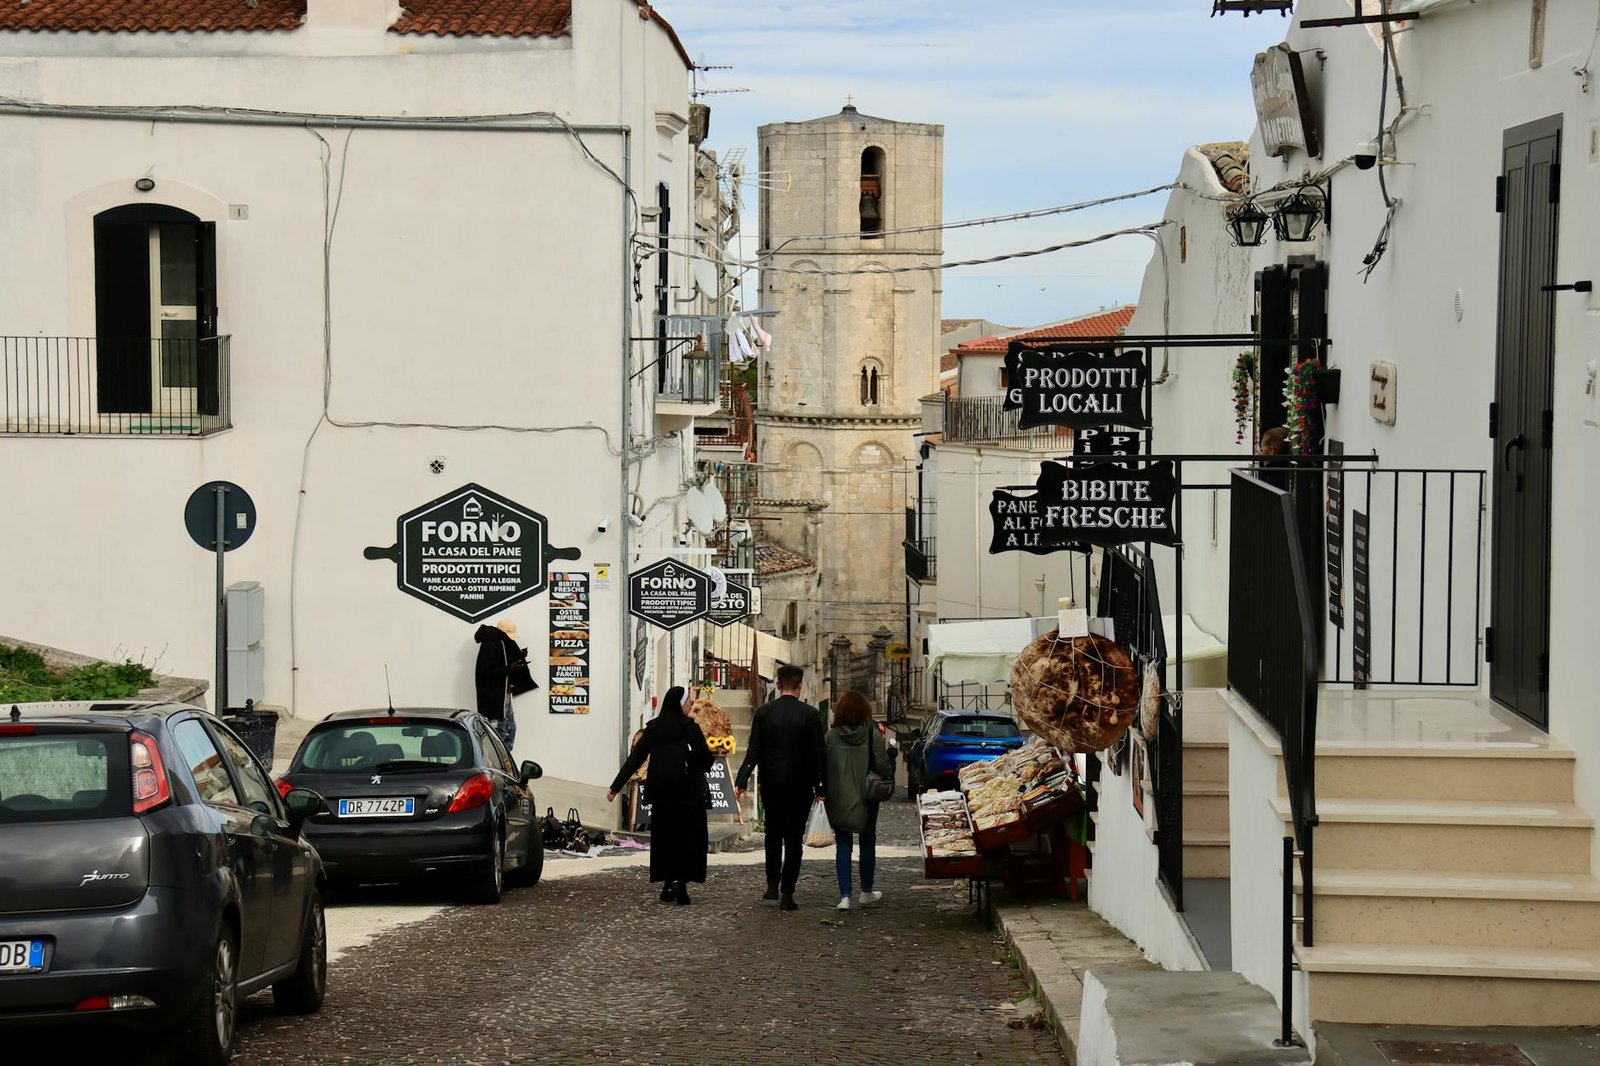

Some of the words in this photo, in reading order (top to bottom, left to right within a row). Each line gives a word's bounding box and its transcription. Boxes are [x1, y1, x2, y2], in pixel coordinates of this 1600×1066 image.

[1025, 367, 1138, 388] PRODOTTI
[1039, 393, 1122, 413] LOCALI
[1061, 479, 1151, 501] BIBITE
[997, 500, 1038, 514] PANE
[1003, 516, 1026, 530] AL
[1045, 506, 1167, 528] FRESCHE
[421, 520, 521, 543] FORNO
[1006, 533, 1019, 546] A
[421, 547, 436, 556] LA
[438, 547, 467, 556] CASA
[469, 547, 490, 556] DEL
[492, 547, 521, 556] PANE
[422, 564, 484, 574] PRODOTTI
[486, 564, 520, 574] TIPICI
[641, 577, 697, 589] FORNO
[718, 599, 745, 609] STO
[551, 696, 587, 704] TARALLI
[711, 762, 724, 771] NO
[709, 783, 720, 791] NE
[348, 801, 363, 813] DR
[367, 800, 404, 813] 774ZP
[711, 800, 729, 808] GNA
[0, 943, 27, 966] DB
